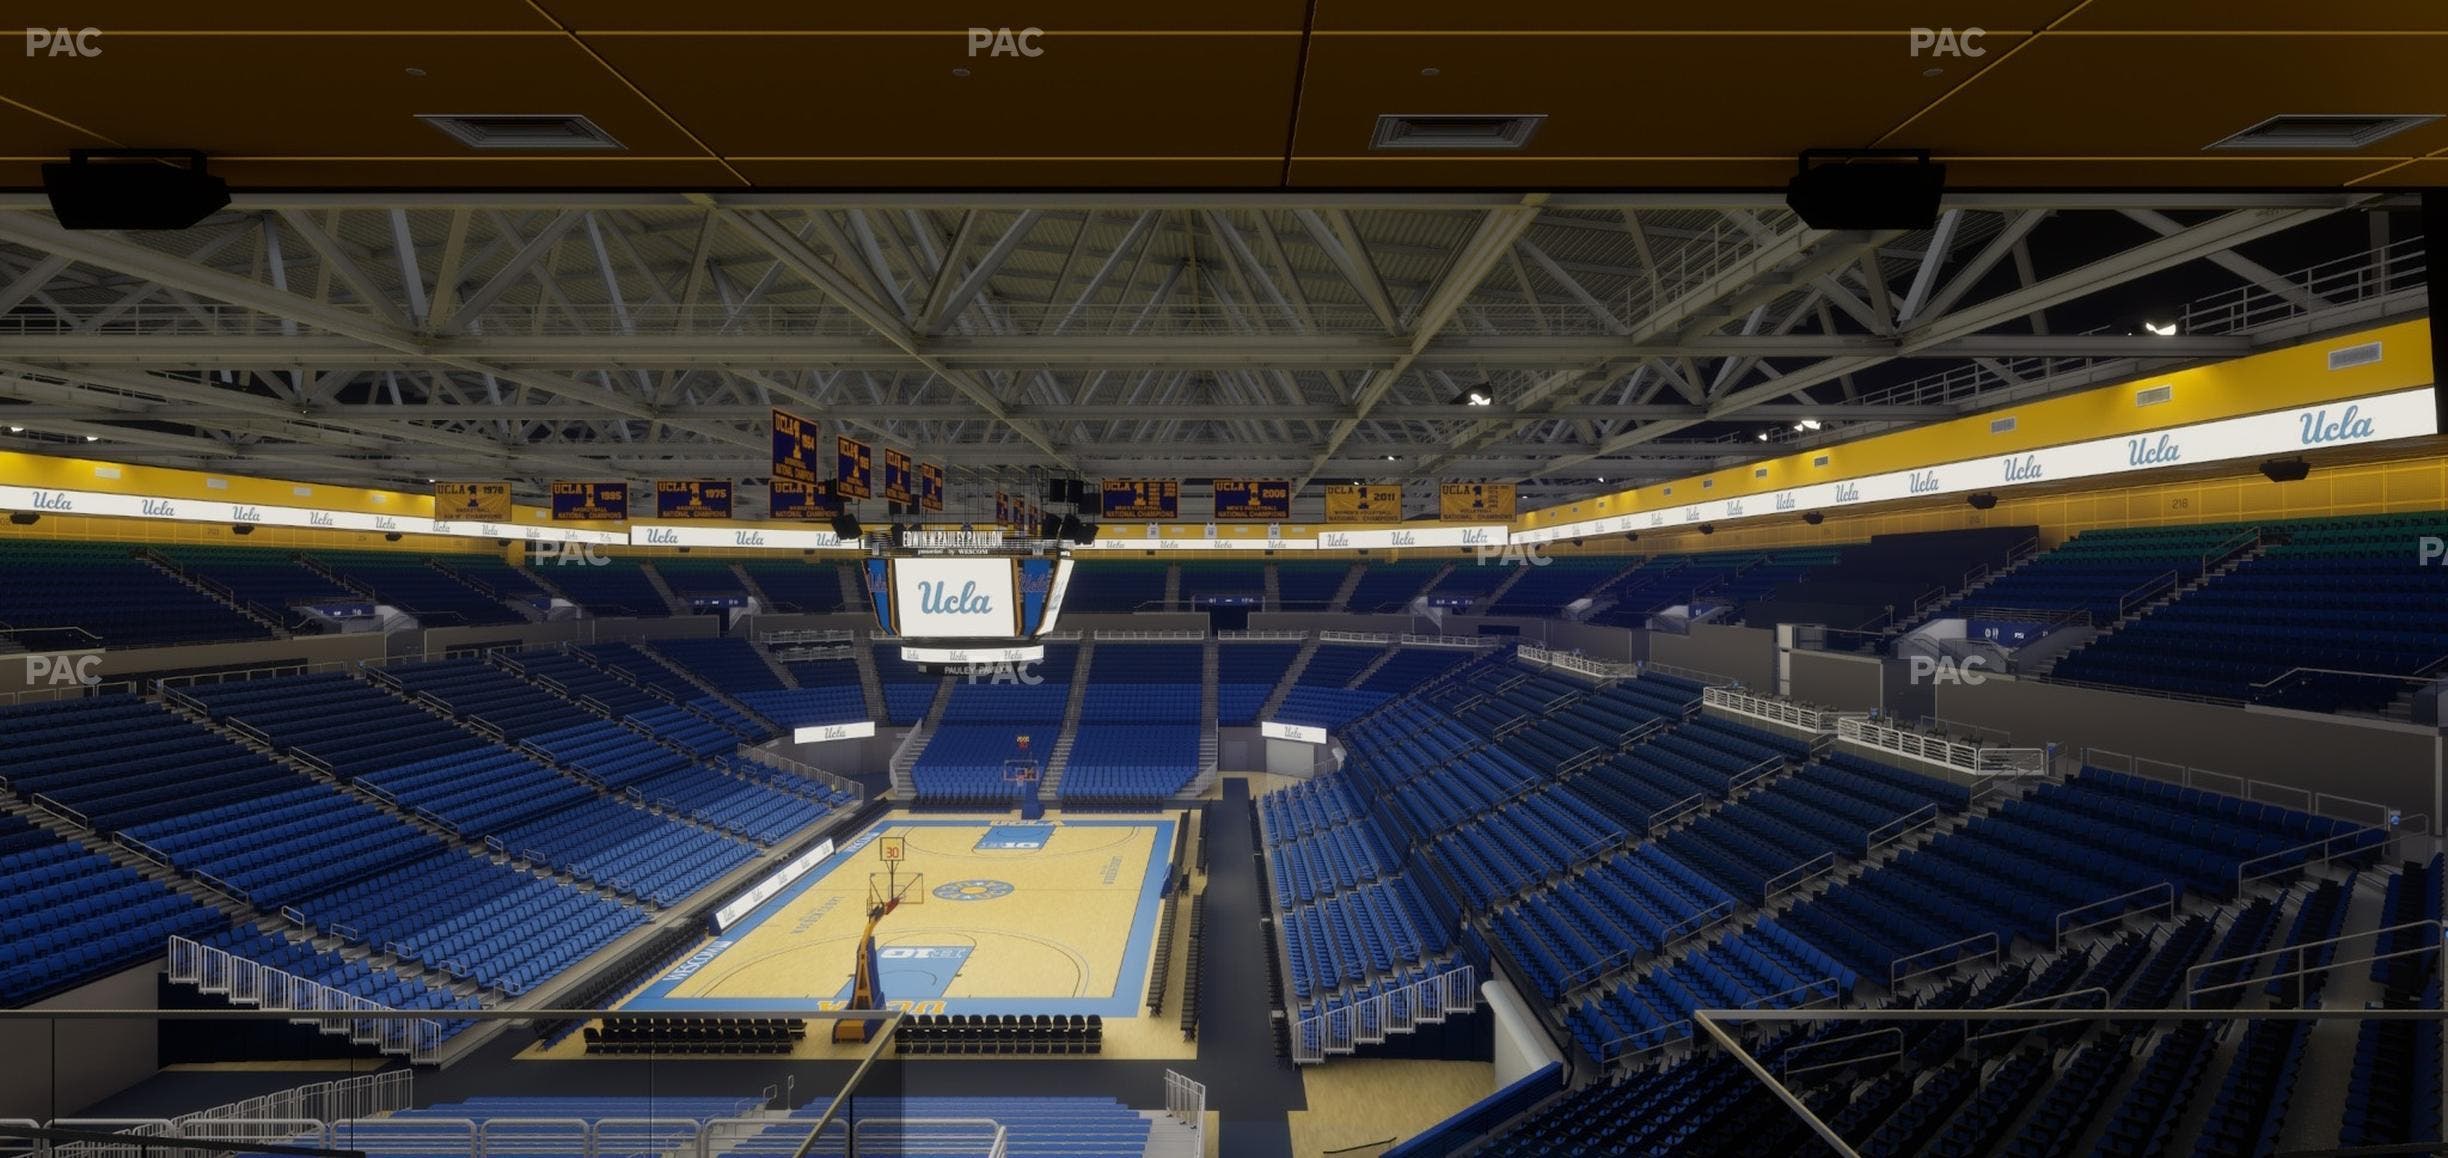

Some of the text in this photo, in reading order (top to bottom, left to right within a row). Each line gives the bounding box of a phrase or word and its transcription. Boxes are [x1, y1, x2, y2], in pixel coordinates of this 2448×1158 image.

[2300, 405, 2375, 444] Ucla
[2128, 434, 2181, 466] Ucla
[2003, 455, 2043, 481] Ucla
[437, 484, 466, 495] UCLA
[553, 483, 583, 495] UCLA
[658, 482, 688, 492] UCLA
[704, 488, 727, 499] 1975
[775, 482, 804, 493] UCLA
[1103, 482, 1131, 491] UCLA
[1216, 482, 1245, 491] UCLA
[1442, 484, 1470, 495] UCLA
[1909, 472, 1939, 493] Ucla
[1327, 486, 1354, 495] UCLA
[1374, 492, 1396, 501] 2011
[1835, 482, 1860, 503] Ucla
[32, 491, 73, 511] Ucla
[142, 499, 175, 517] Ucla
[1776, 491, 1796, 511] Ucla
[232, 505, 261, 522] Ucla
[310, 511, 333, 526] Ucla
[1105, 510, 1175, 518] NATIONAL CHAMPIONS
[1217, 510, 1287, 518] NATIONAL CHAMPIONS
[375, 516, 396, 530] Ucla
[646, 528, 679, 545] Ucla
[735, 530, 764, 546] Ucla
[937, 530, 965, 547] PAULEY
[966, 530, 1003, 547] PAVILION
[1327, 533, 1349, 548] Ucla
[1391, 531, 1415, 546] Ucla
[1462, 528, 1488, 544] Ucla
[918, 580, 993, 615] Ucla
[944, 665, 976, 675] PAULEY
[886, 846, 900, 859] 30
[662, 940, 734, 982] WESCOM
